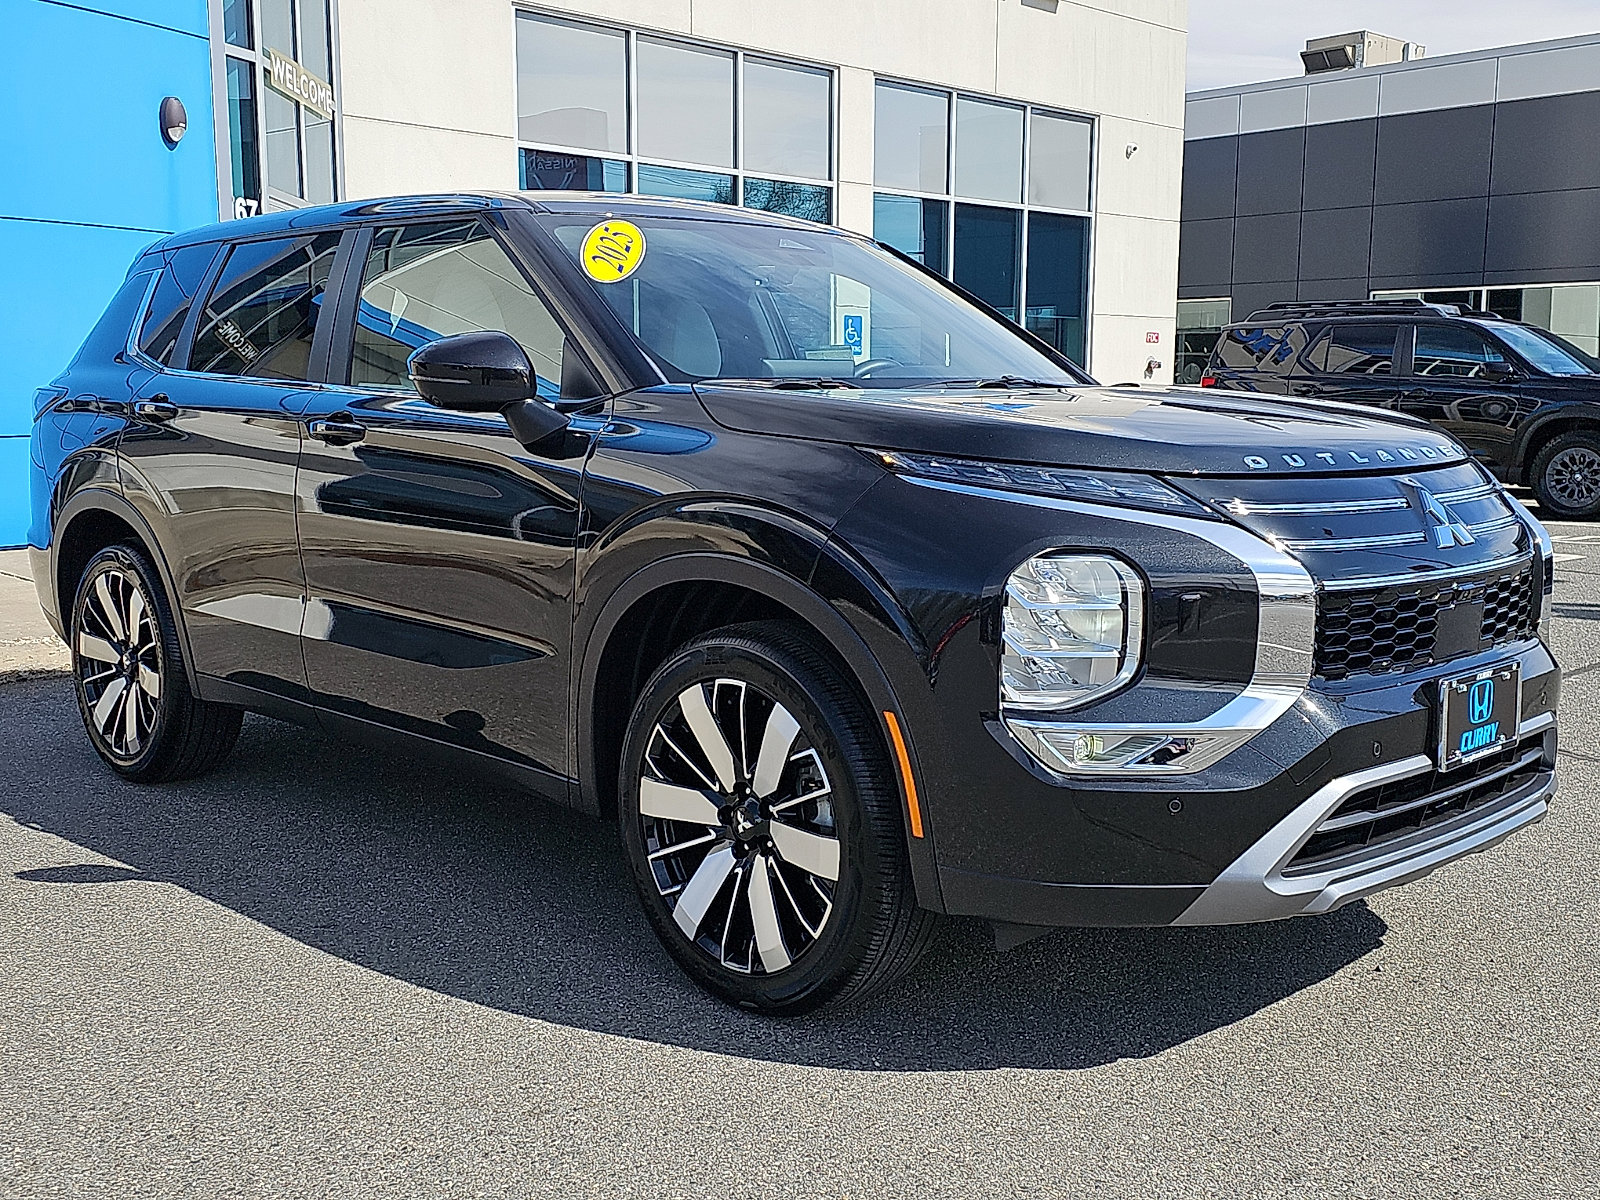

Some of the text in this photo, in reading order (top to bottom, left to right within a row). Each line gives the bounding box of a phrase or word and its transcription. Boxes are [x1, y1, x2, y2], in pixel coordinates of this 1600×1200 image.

[270, 51, 333, 115] WELCOME
[235, 197, 258, 219] 67
[592, 226, 633, 273] 2025
[1460, 722, 1499, 752] CURRY
